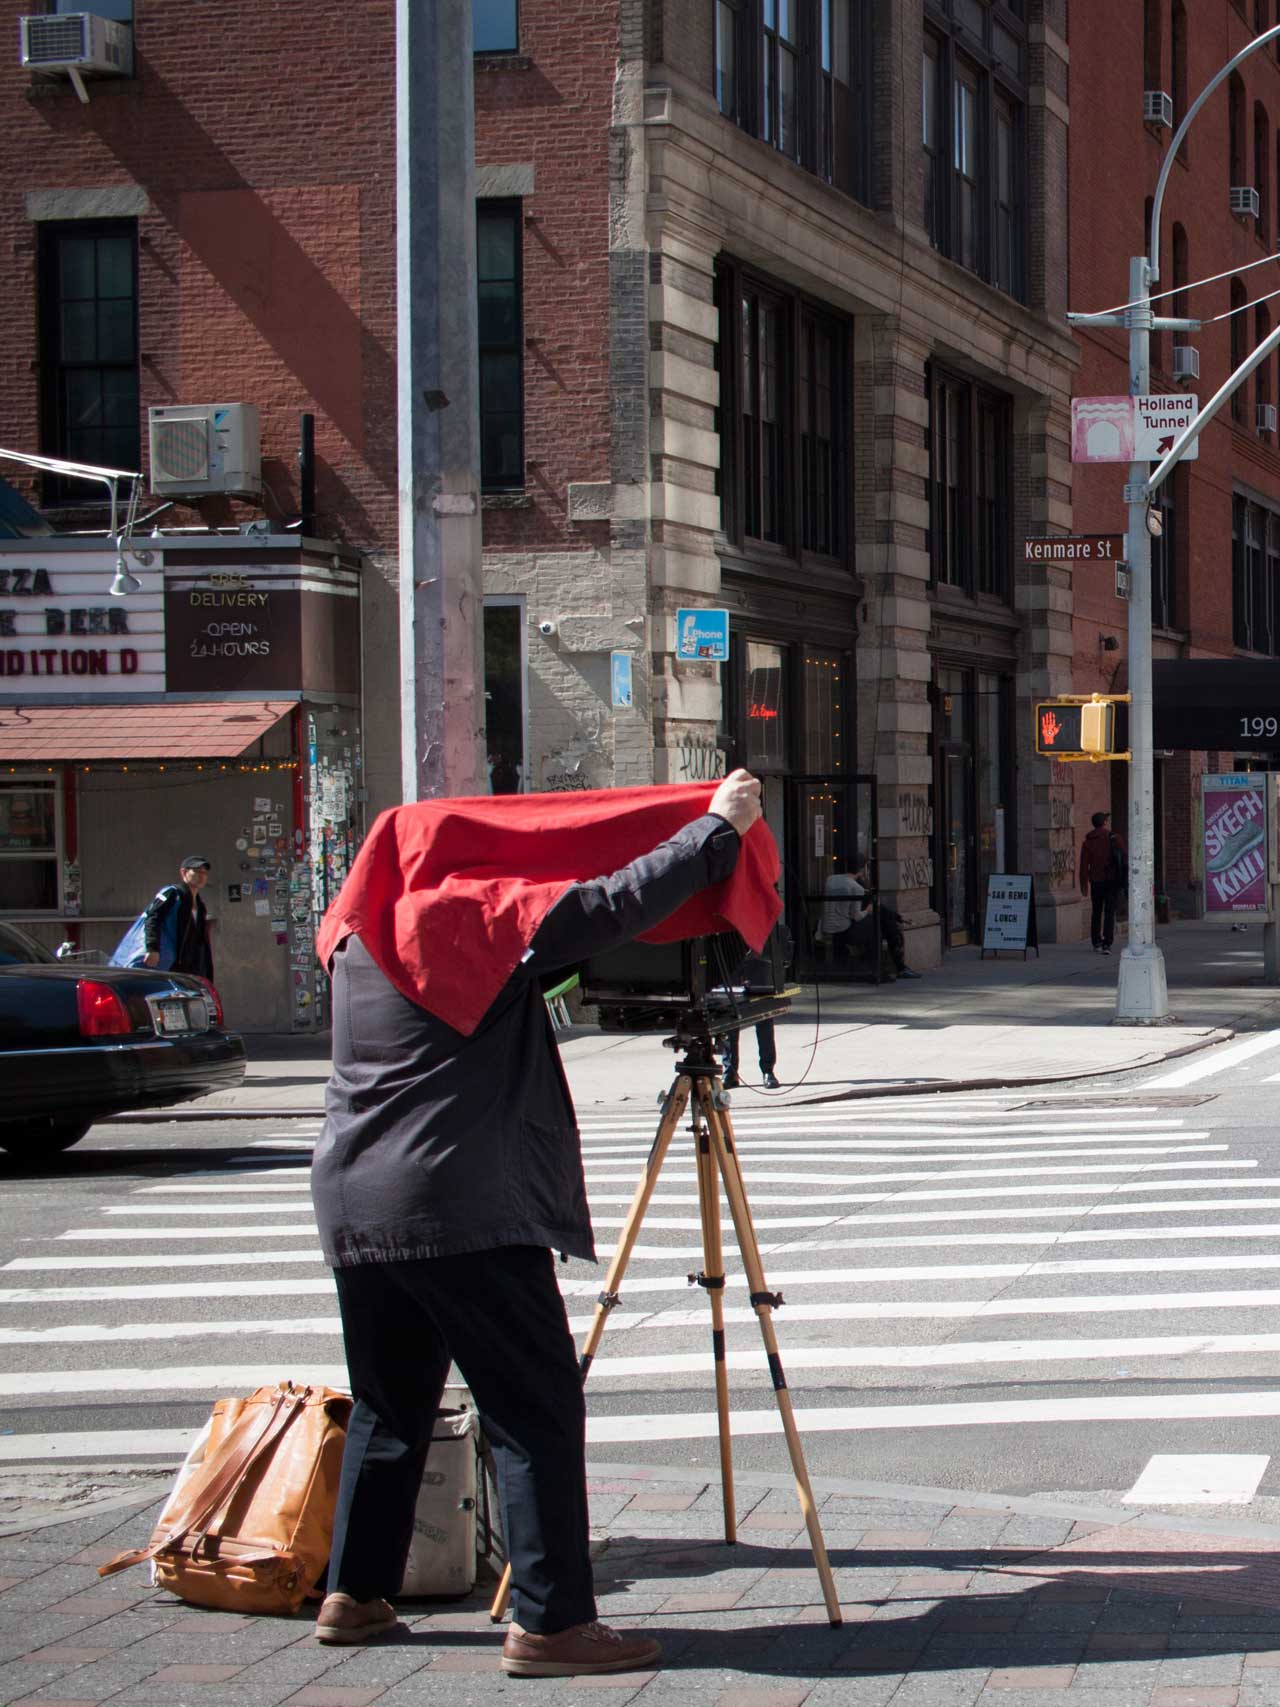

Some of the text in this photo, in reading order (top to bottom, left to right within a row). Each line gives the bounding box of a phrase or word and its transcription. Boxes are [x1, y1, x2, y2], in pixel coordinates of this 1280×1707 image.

[1138, 397, 1193, 411] Holland
[1143, 416, 1189, 429] Tunnel
[1025, 540, 1112, 559] Kenmare St
[190, 593, 269, 607] DELIVERY
[45, 608, 129, 635] BEER
[207, 622, 252, 637] OPEN
[694, 629, 723, 640] Phone
[1240, 717, 1278, 737] 199
[1219, 776, 1249, 785] TITAN
[1205, 790, 1264, 856] SKECH
